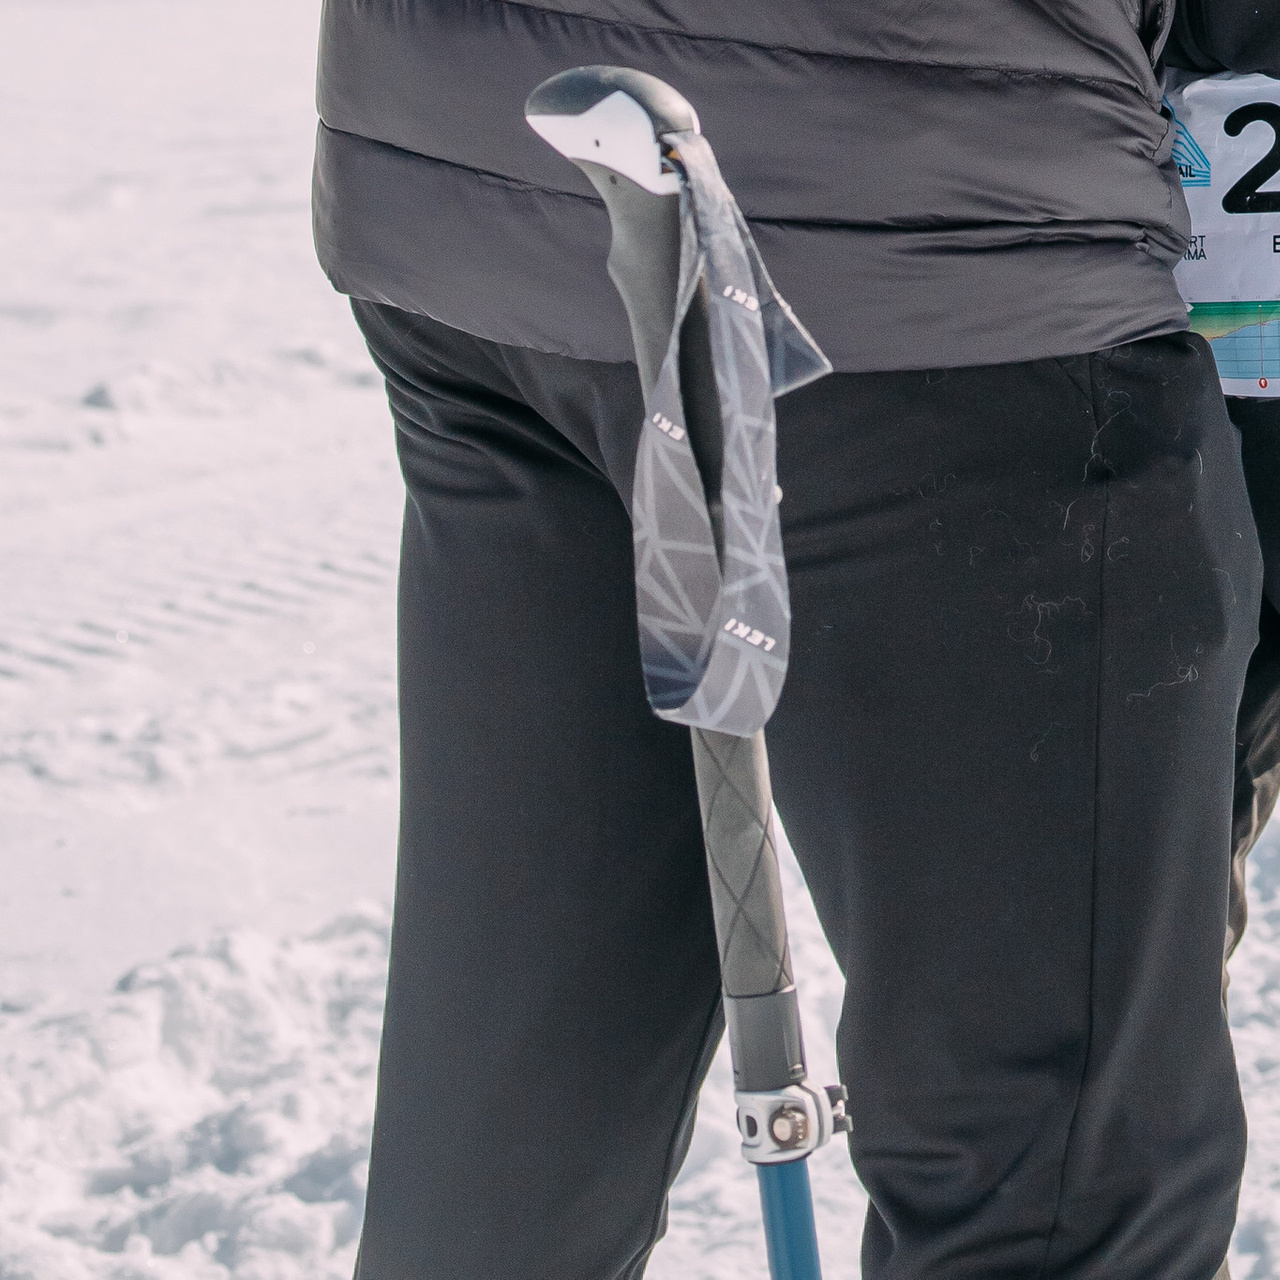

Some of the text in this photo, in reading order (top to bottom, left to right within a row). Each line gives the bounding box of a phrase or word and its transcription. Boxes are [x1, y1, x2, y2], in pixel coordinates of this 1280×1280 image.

[722, 285, 759, 311] EKI
[652, 412, 685, 441] EKI
[723, 618, 776, 652] LEKI
